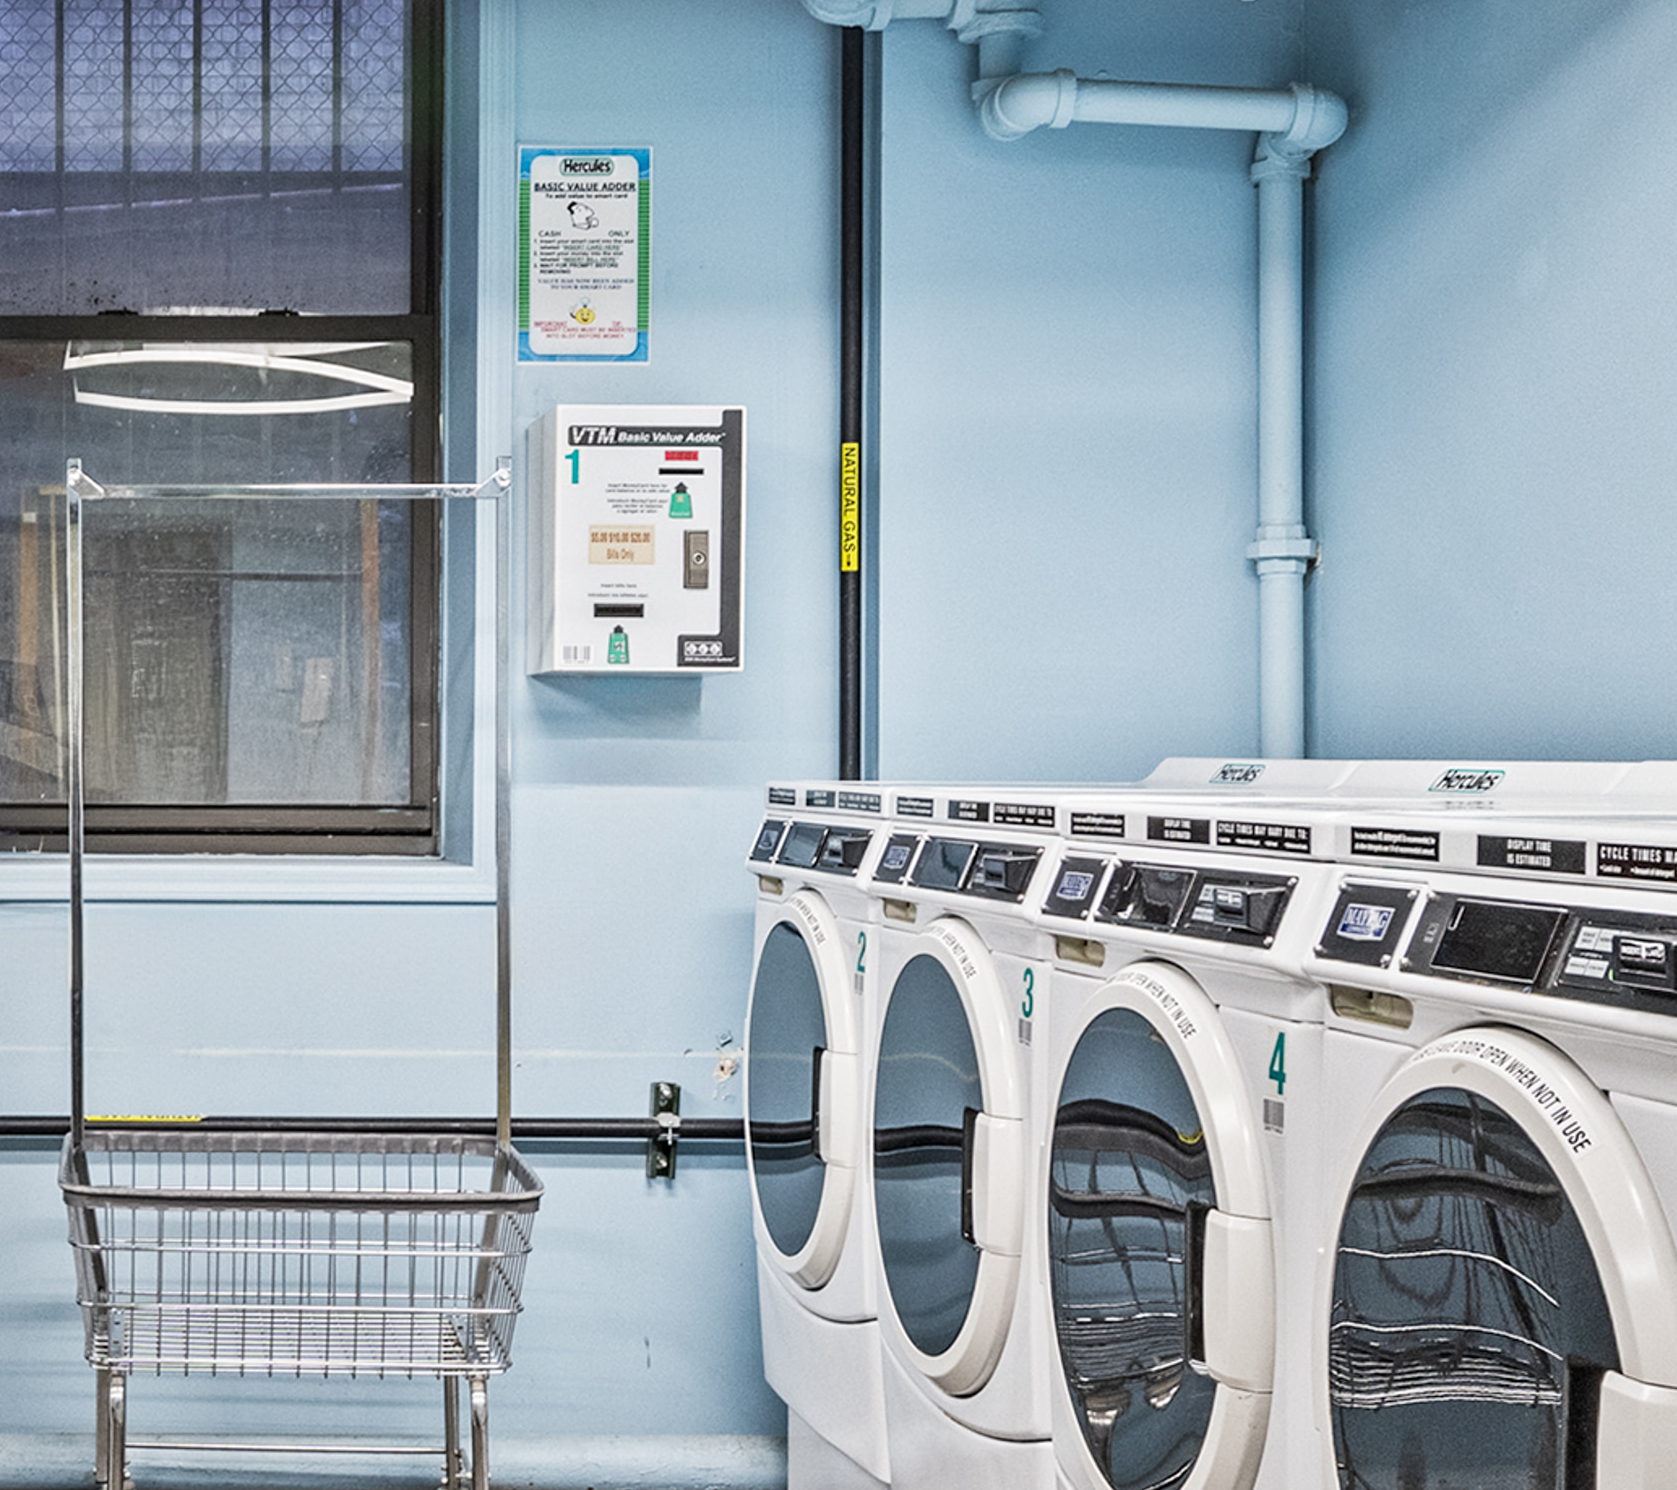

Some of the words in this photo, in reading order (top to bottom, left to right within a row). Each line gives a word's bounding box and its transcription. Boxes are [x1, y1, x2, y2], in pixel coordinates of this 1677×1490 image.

[563, 159, 611, 173] Hercules
[534, 183, 564, 192] BASIC
[568, 183, 598, 192] VALUE
[601, 183, 636, 192] ADDER
[572, 427, 616, 443] VTM
[618, 432, 650, 443] Basic
[653, 433, 683, 442] Value
[565, 449, 579, 484] 1
[844, 447, 856, 517] NATURAL
[844, 522, 856, 554] GAS
[1437, 771, 1499, 792] Hercules
[857, 932, 867, 972] 2
[1022, 968, 1034, 1018] 3
[1268, 1032, 1287, 1095] 4
[1481, 1044, 1507, 1068] OPEN
[1504, 1059, 1538, 1091] WHEN
[1532, 1083, 1560, 1110] NOT
[1553, 1107, 1571, 1127] IN
[1563, 1121, 1593, 1155] USE
